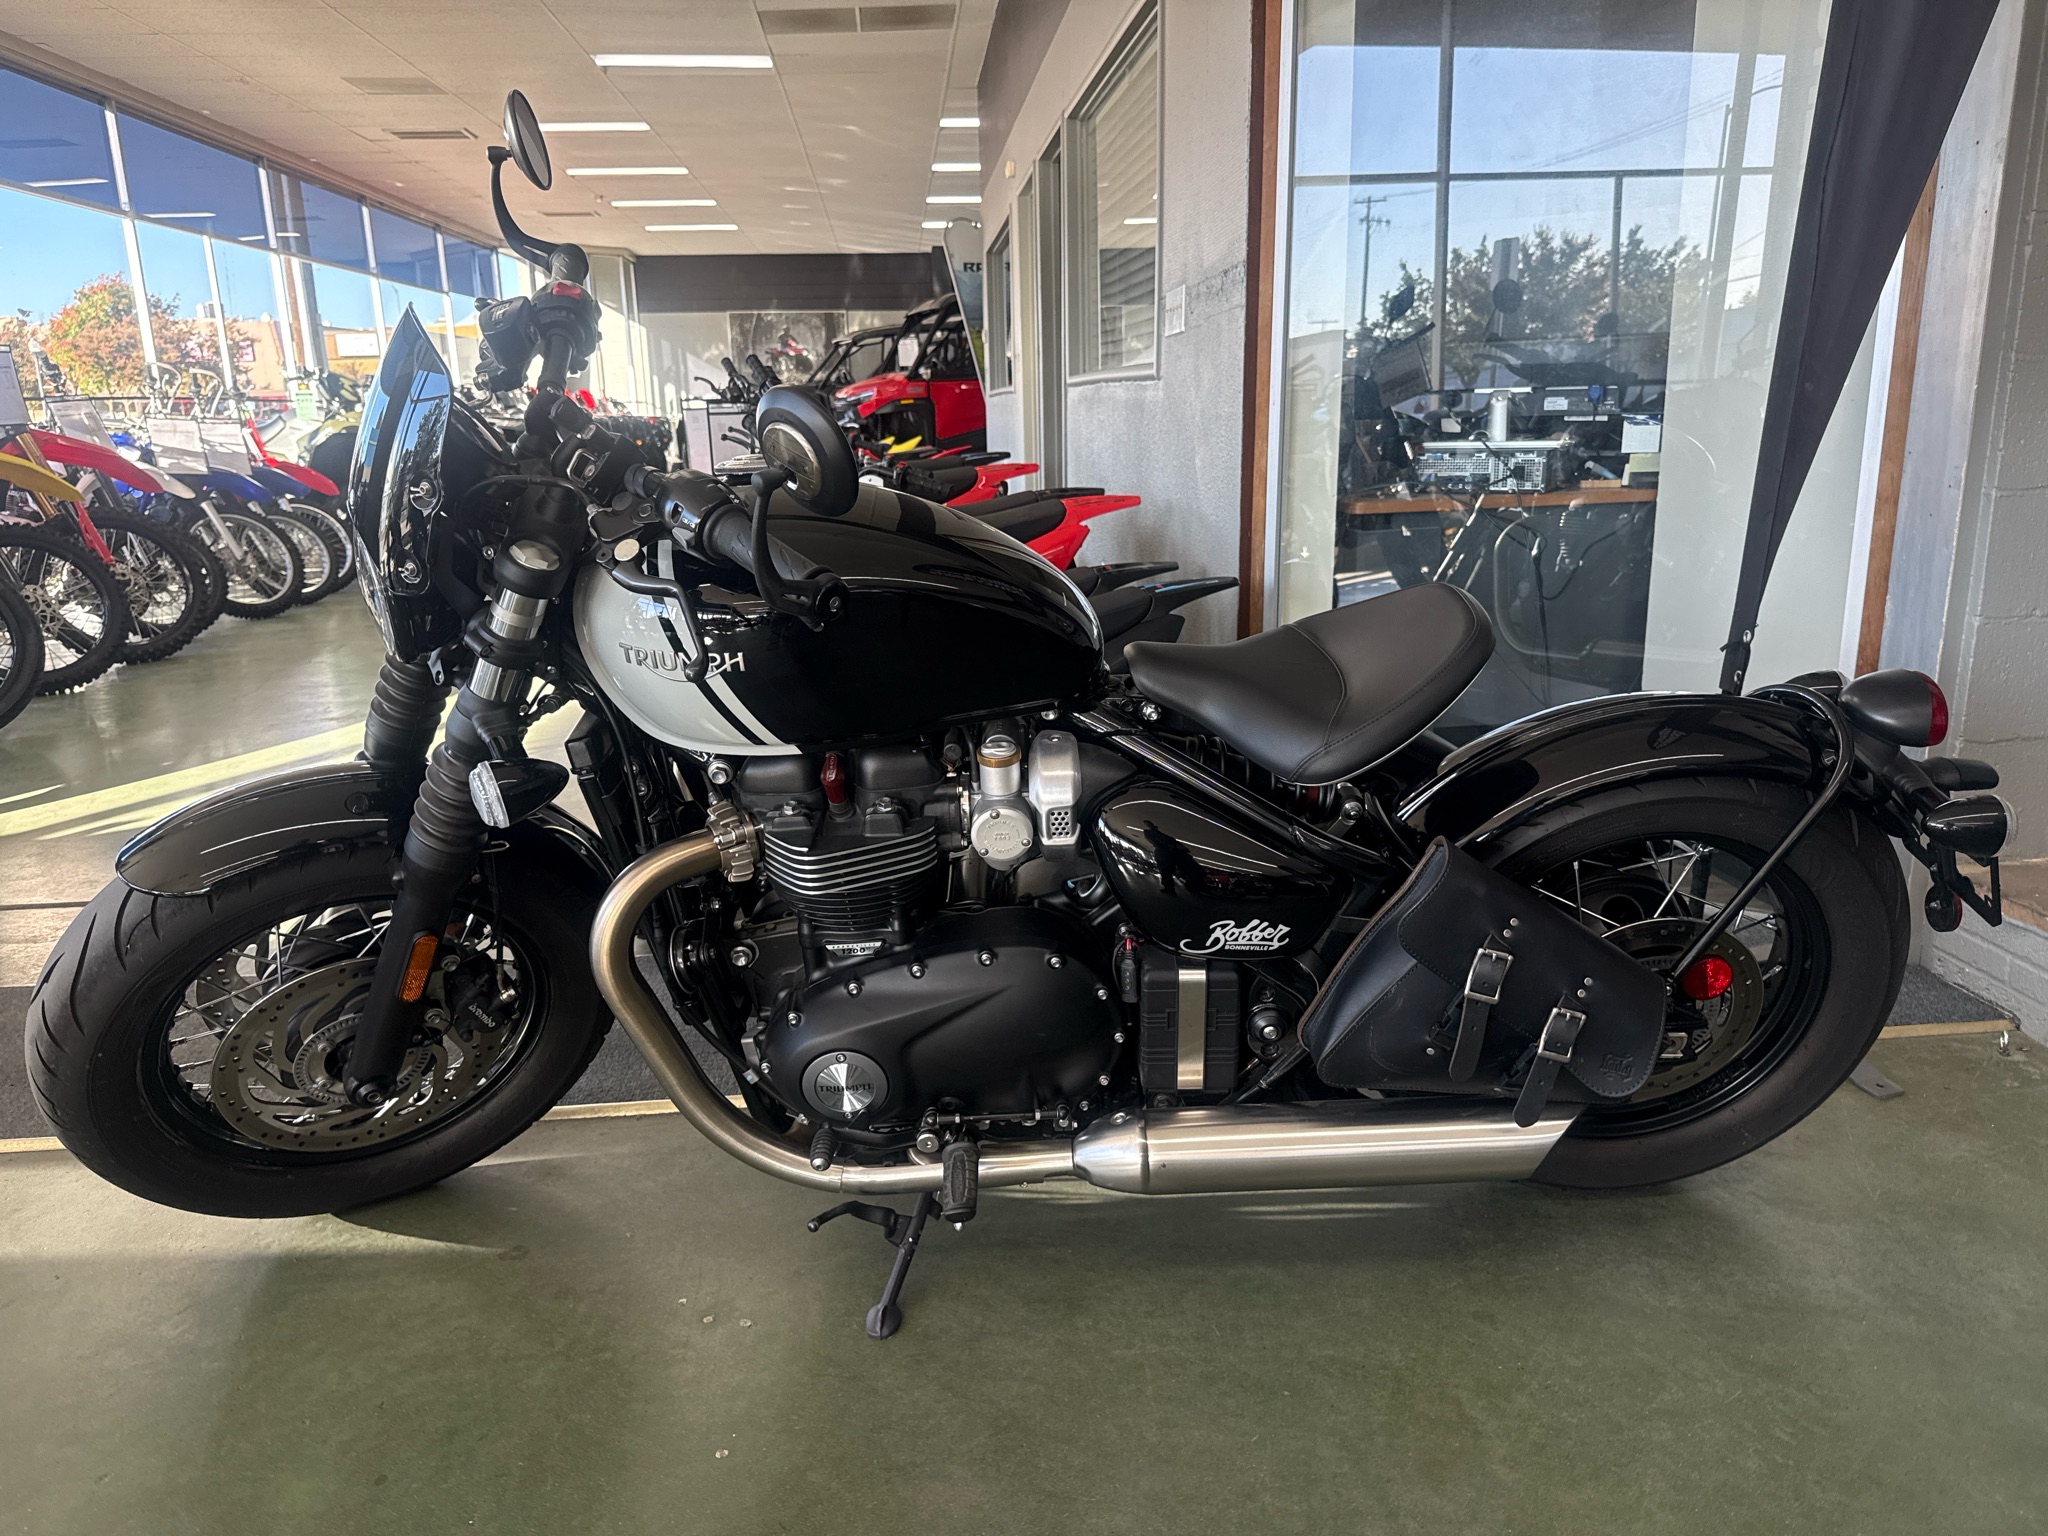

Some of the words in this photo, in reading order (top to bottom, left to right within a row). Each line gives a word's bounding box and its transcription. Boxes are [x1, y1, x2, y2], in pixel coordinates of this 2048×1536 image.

[1180, 919, 1291, 953] Bobber
[841, 947, 866, 955] 1200
[468, 1002, 496, 1028] brembo
[818, 1083, 872, 1094] TRIUMPH
